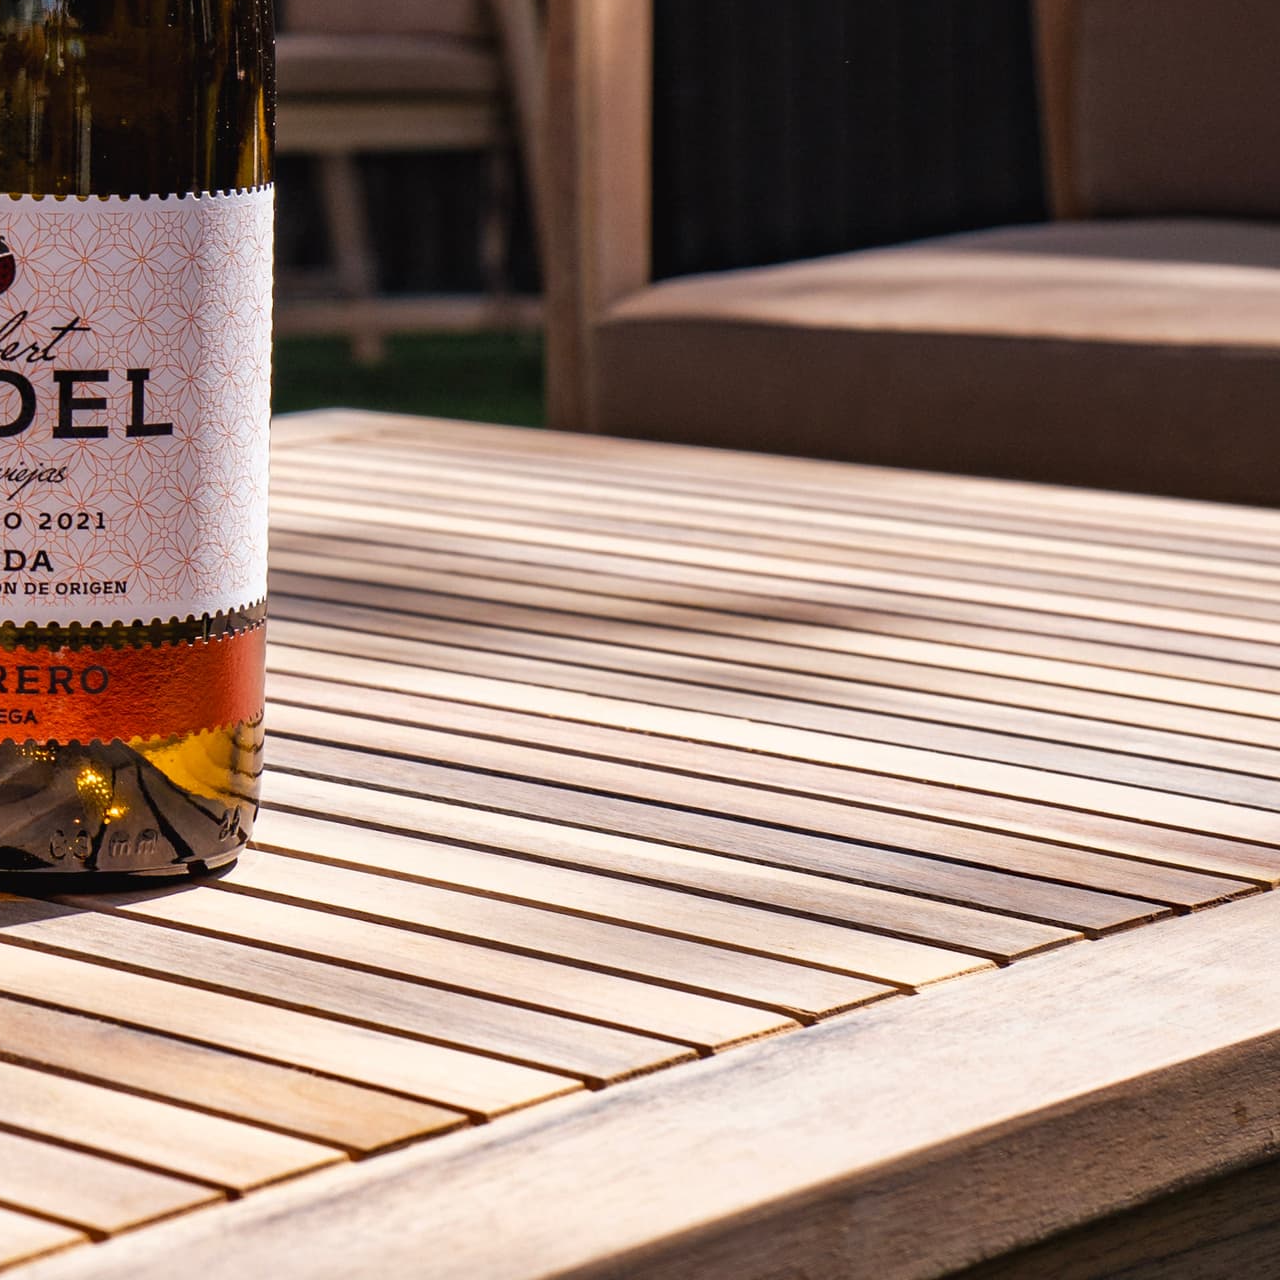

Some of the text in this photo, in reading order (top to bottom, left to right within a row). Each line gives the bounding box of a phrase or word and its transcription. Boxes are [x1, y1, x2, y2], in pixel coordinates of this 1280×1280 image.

[39, 511, 106, 530] 2021
[23, 581, 49, 596] DE
[55, 580, 128, 596] ORIGEN
